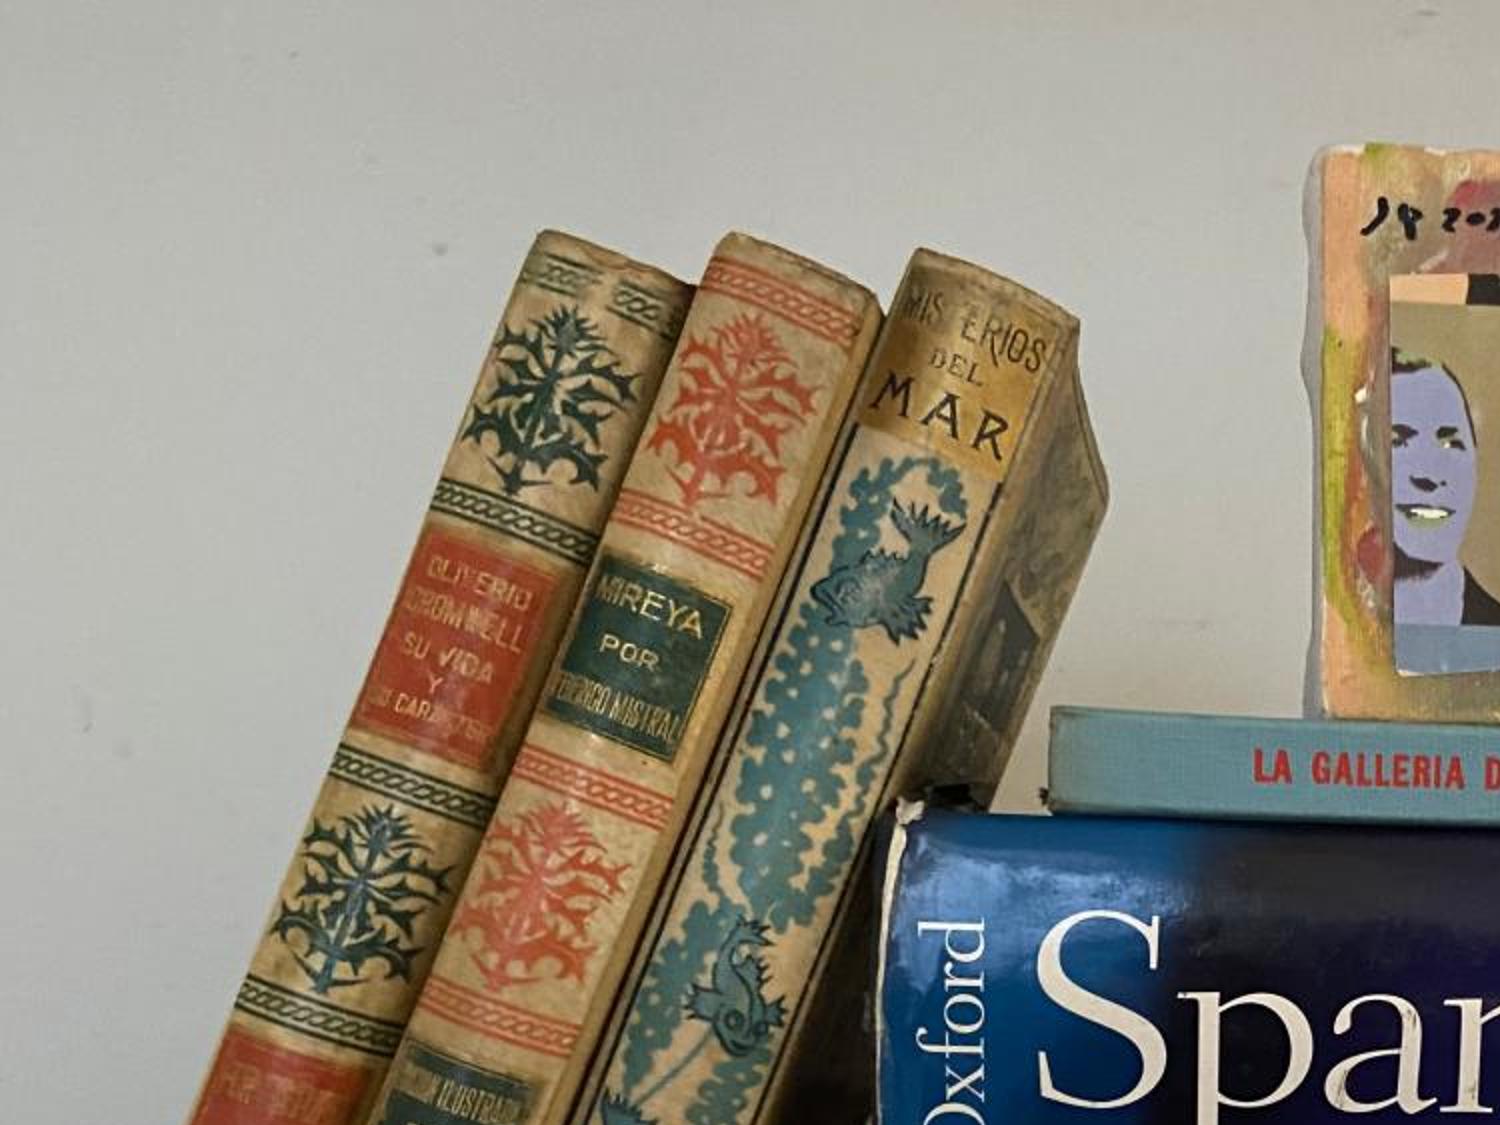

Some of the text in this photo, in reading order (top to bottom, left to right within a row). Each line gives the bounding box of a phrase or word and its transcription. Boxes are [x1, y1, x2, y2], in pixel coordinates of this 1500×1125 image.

[902, 290, 1047, 374] MISERIOS
[930, 348, 983, 386] DEL
[869, 369, 1009, 461] MAR
[597, 576, 703, 640] MIREYA
[403, 632, 496, 684] SU VIDA
[599, 633, 661, 672] POR
[428, 674, 443, 694] Y
[1253, 748, 1292, 784] LA
[1311, 750, 1465, 790] GALLERIA
